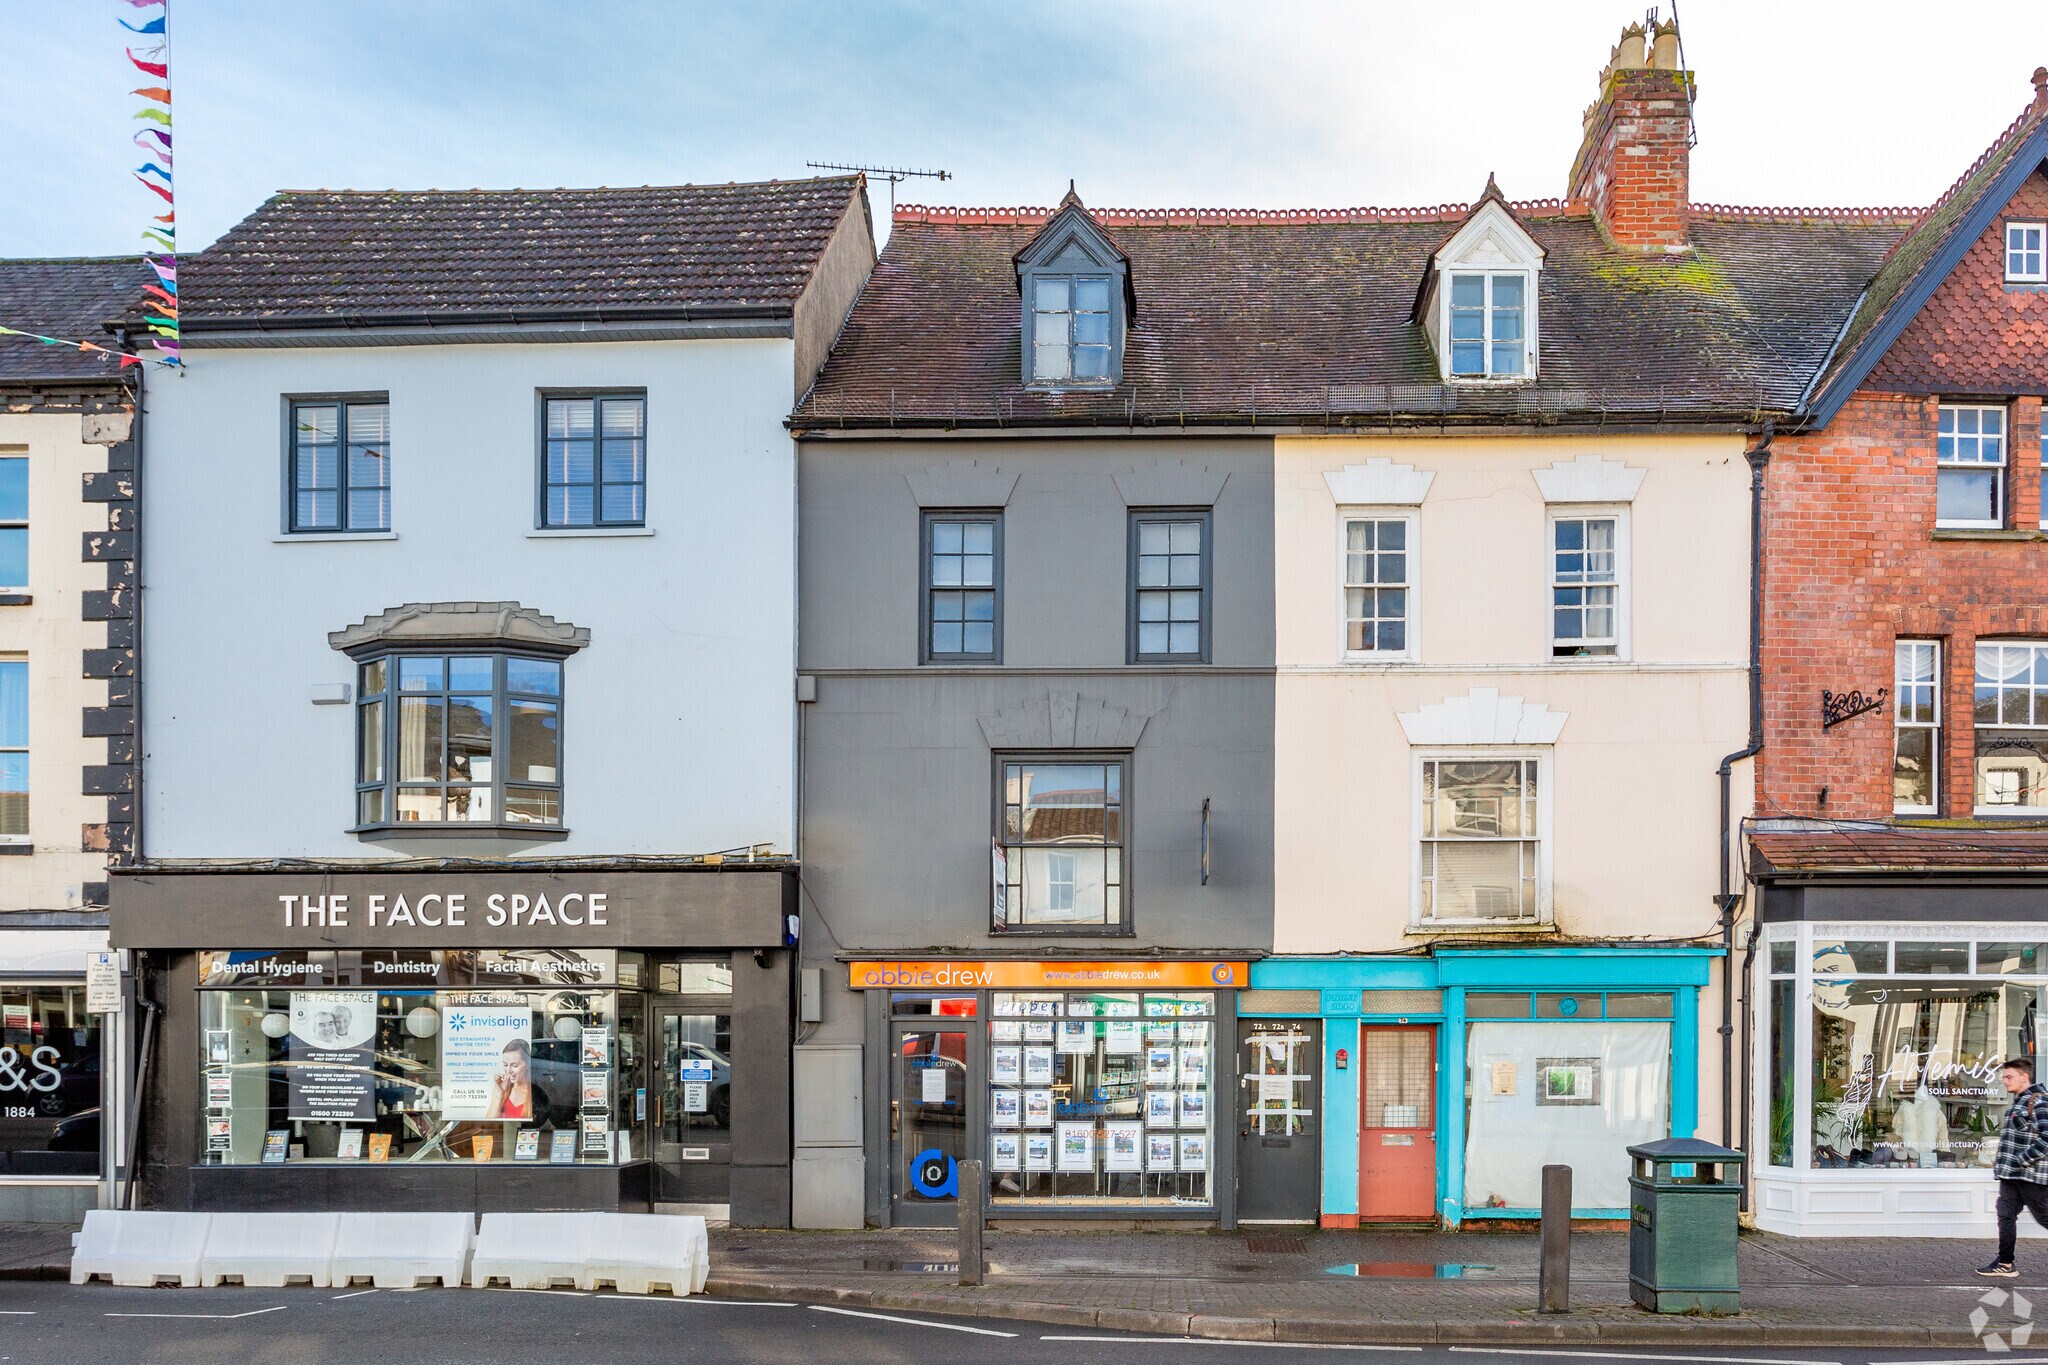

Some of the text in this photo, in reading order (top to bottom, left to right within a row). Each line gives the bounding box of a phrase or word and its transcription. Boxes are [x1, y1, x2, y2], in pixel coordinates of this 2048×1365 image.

[279, 892, 608, 927] THE FACE SPACE
[212, 961, 323, 977] Dental Hygiene
[374, 960, 440, 977] Dentistry
[486, 960, 606, 973] Facial Aesthetics
[865, 963, 994, 985] abbiedrew
[1045, 970, 1160, 979] www.abbiedrew.co.uk
[294, 993, 373, 1003] THE FACE SPACE
[450, 995, 527, 1004] THE FACE SPACE
[471, 1015, 528, 1030] invisalign
[1877, 1044, 2006, 1098] Artemis
[4, 1106, 35, 1118] 1884
[1065, 1129, 1137, 1139] 01600 527 527
